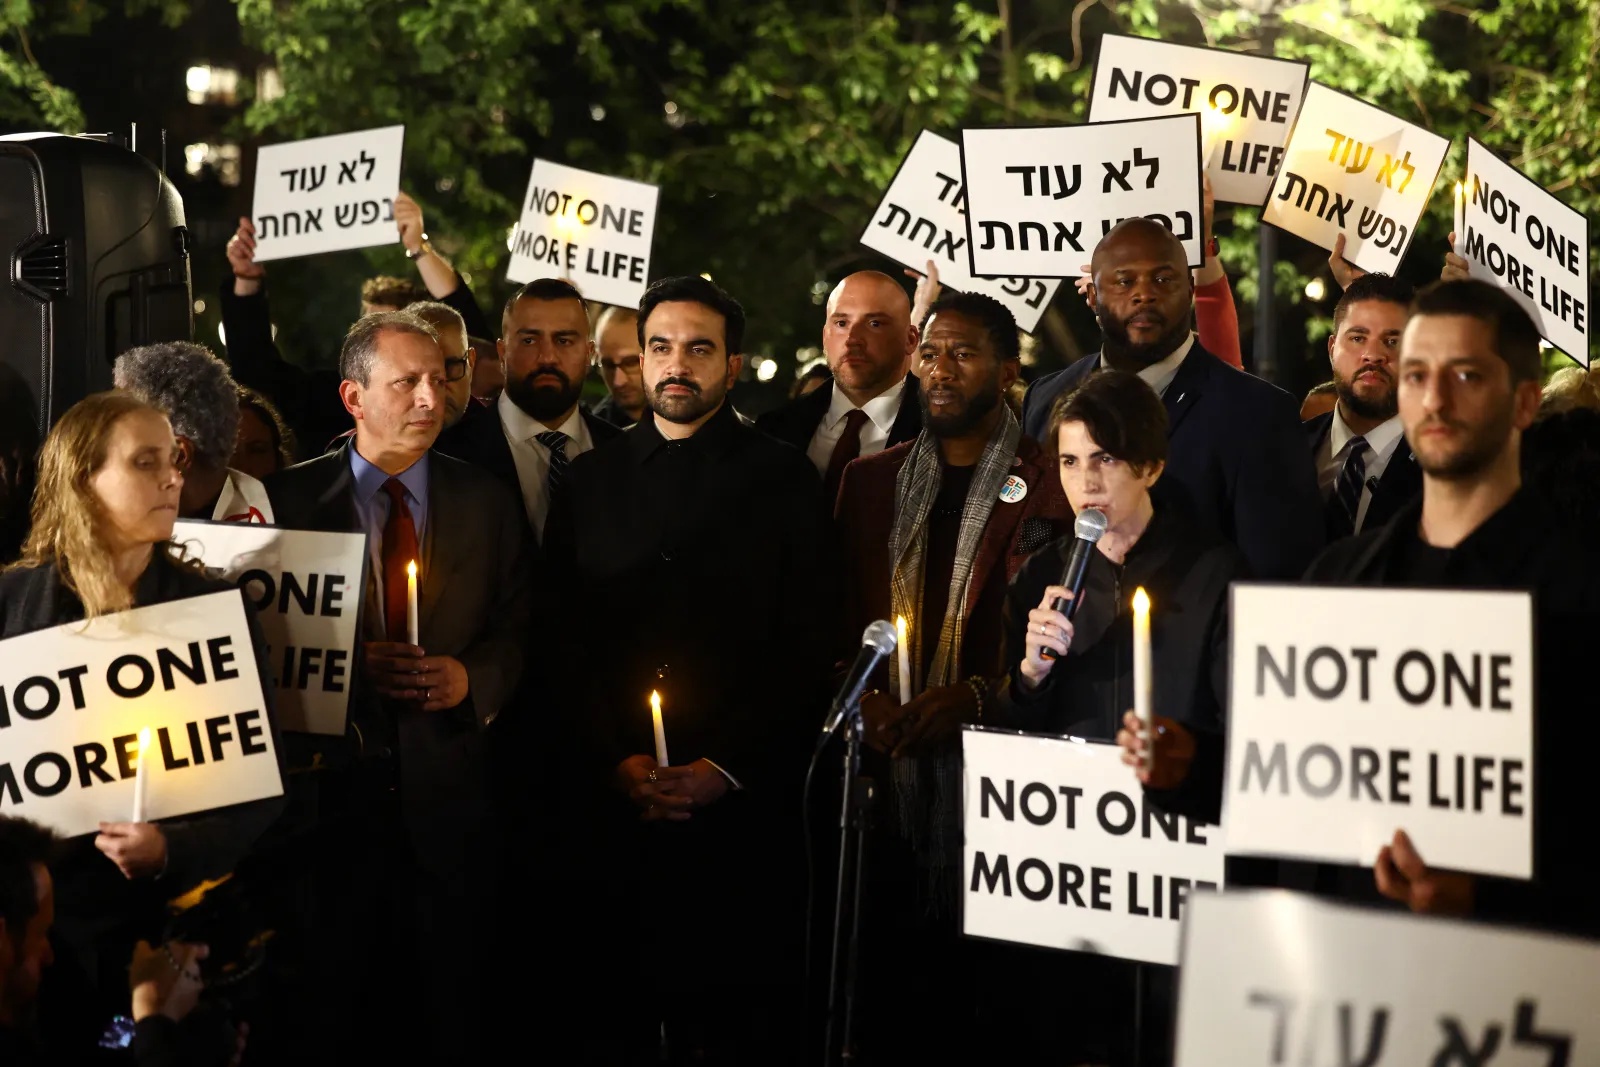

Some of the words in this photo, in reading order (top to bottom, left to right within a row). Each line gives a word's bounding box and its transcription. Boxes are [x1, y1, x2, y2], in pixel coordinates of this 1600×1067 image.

[1108, 67, 1200, 109] NOT
[1208, 83, 1291, 124] ONE
[337, 150, 376, 185] לא
[1101, 147, 1160, 193] לא
[1325, 128, 1374, 173] עוד
[1376, 150, 1416, 194] לא
[280, 164, 327, 192] עוד
[935, 171, 966, 216] וד
[1005, 164, 1082, 200] עוד
[1277, 171, 1355, 229] אחת
[258, 208, 323, 240] אחת
[335, 198, 395, 228] נפש
[529, 186, 572, 216] NOT
[577, 199, 644, 237] ONE
[877, 202, 966, 263] אחת
[978, 220, 1085, 252] אחת
[1357, 205, 1408, 256] נפש
[1472, 173, 1520, 234] NOT
[1525, 214, 1579, 277] ONE
[516, 230, 578, 270] MORE
[586, 247, 645, 283] LIFE
[1465, 225, 1534, 300] MORE
[1540, 276, 1585, 335] LIFE
[981, 277, 1048, 310] נפ
[237, 568, 346, 618] ONE
[106, 635, 239, 699] ONE
[268, 645, 347, 693] IFE
[1255, 644, 1379, 702] NOT
[1393, 648, 1514, 712] ONE
[157, 709, 268, 771] LIFE
[979, 776, 1083, 830] NOT
[1239, 740, 1412, 806] MORE
[1427, 749, 1525, 818] LIFE
[970, 851, 1112, 912] MORE
[1128, 871, 1217, 921] LIF
